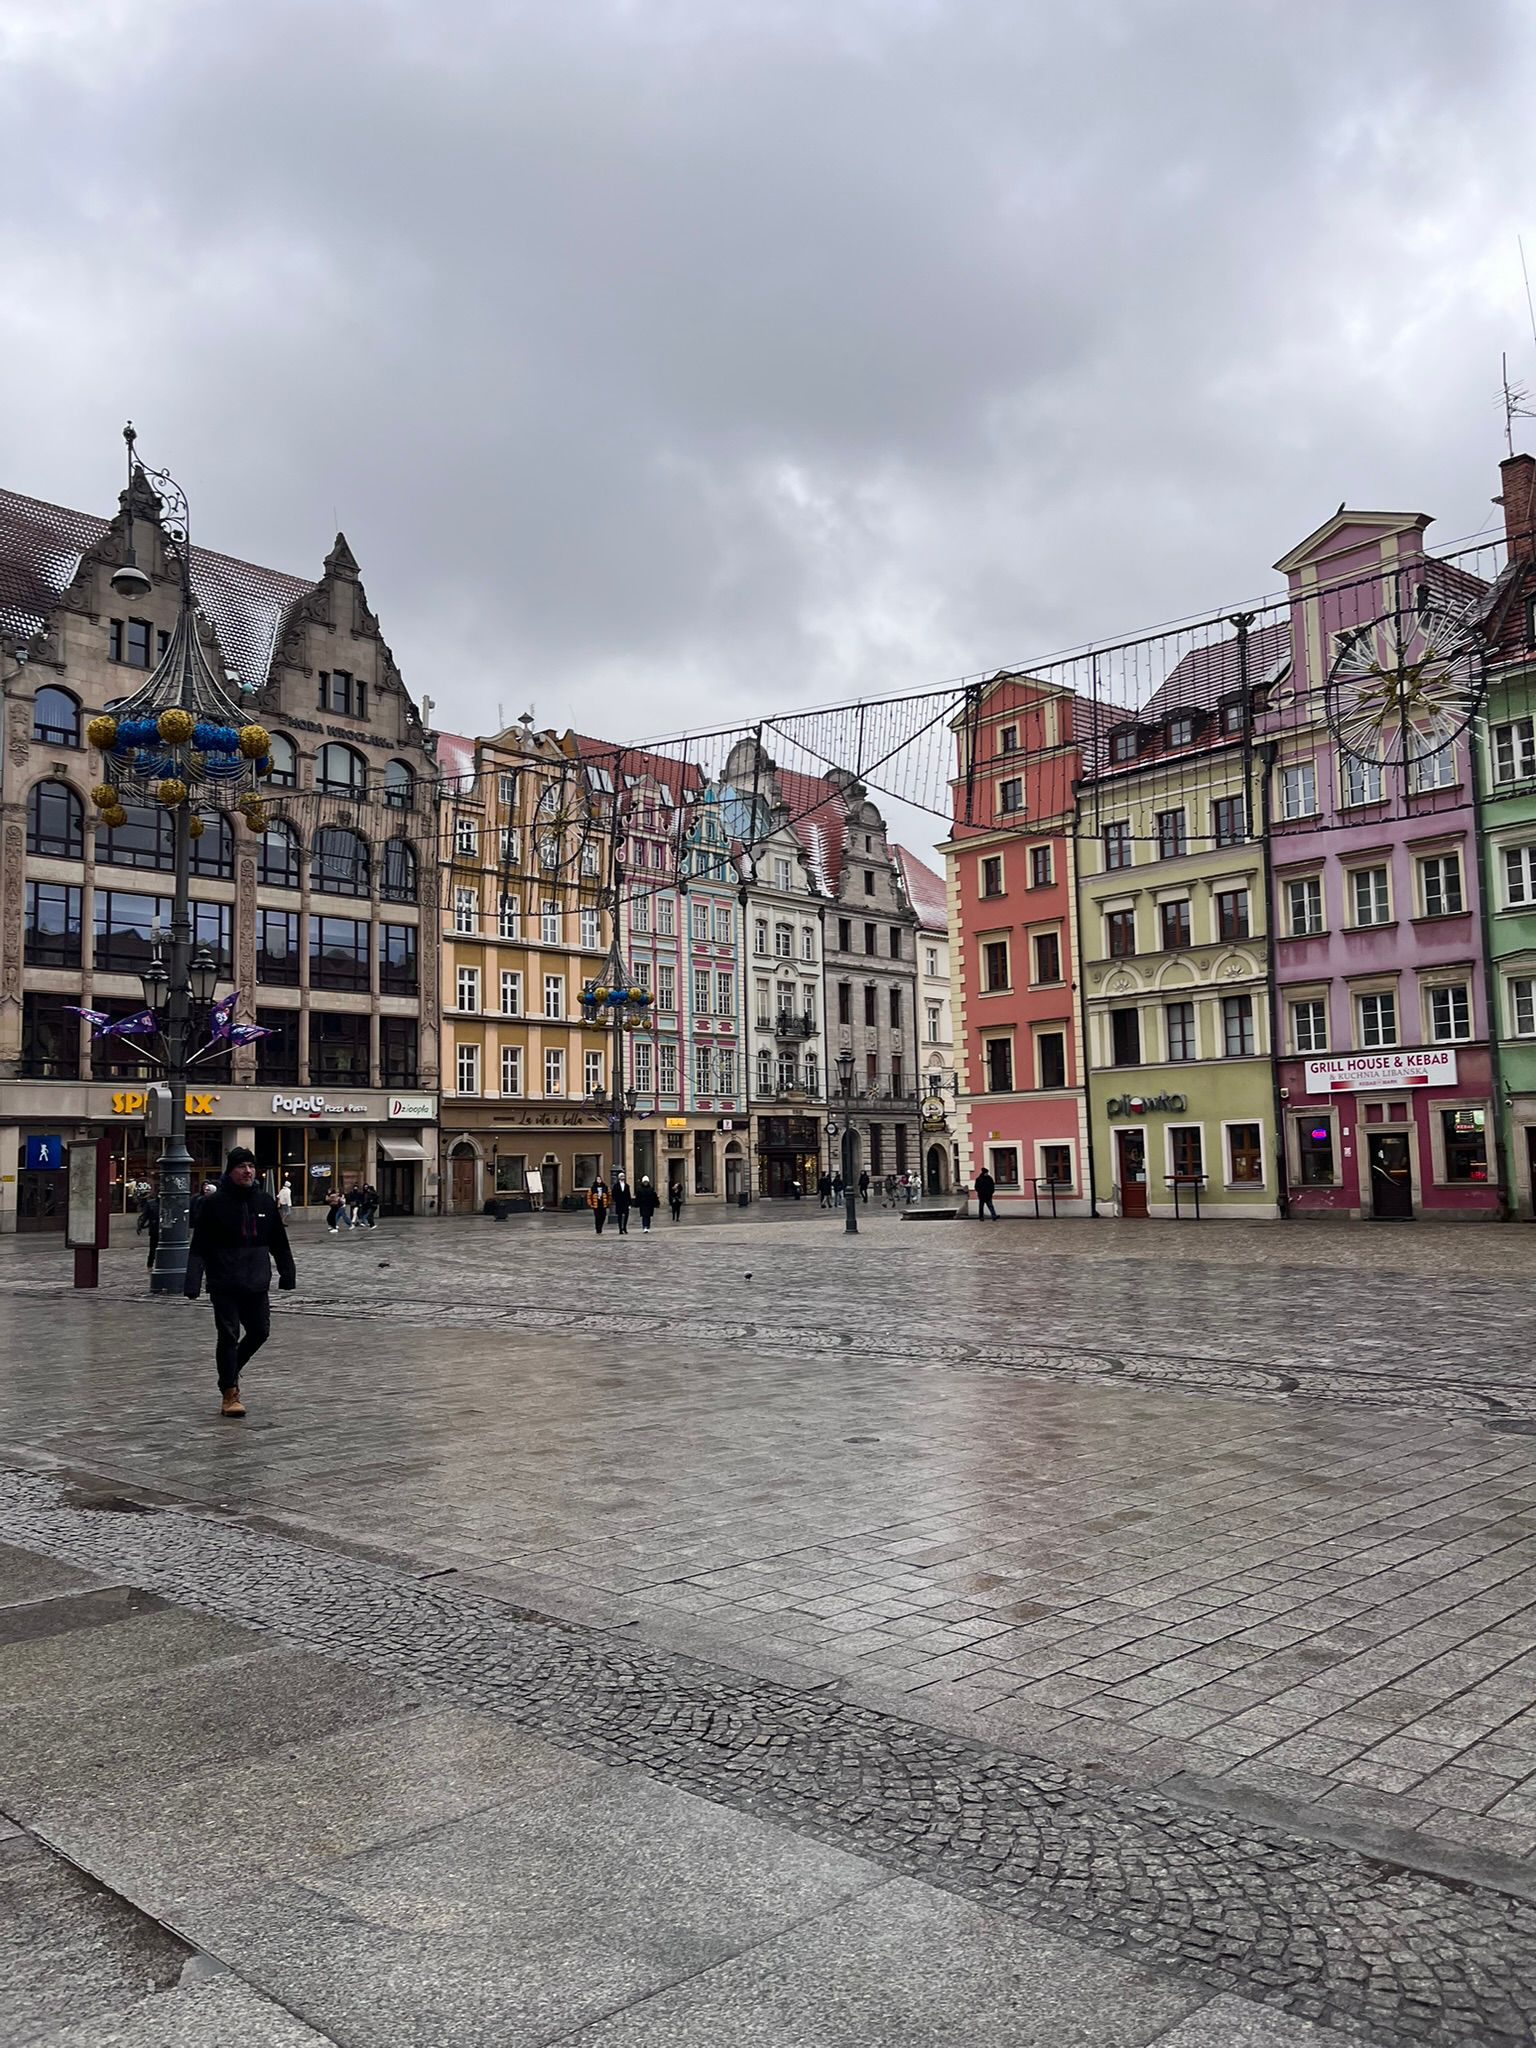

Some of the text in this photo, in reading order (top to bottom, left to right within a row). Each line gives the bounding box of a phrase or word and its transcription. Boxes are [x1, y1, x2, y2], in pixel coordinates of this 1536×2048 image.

[1311, 1053, 1449, 1073] GRILL HOUSE & KEBAB
[1338, 1071, 1380, 1081] KUCHNIA
[111, 1092, 214, 1115] SPX
